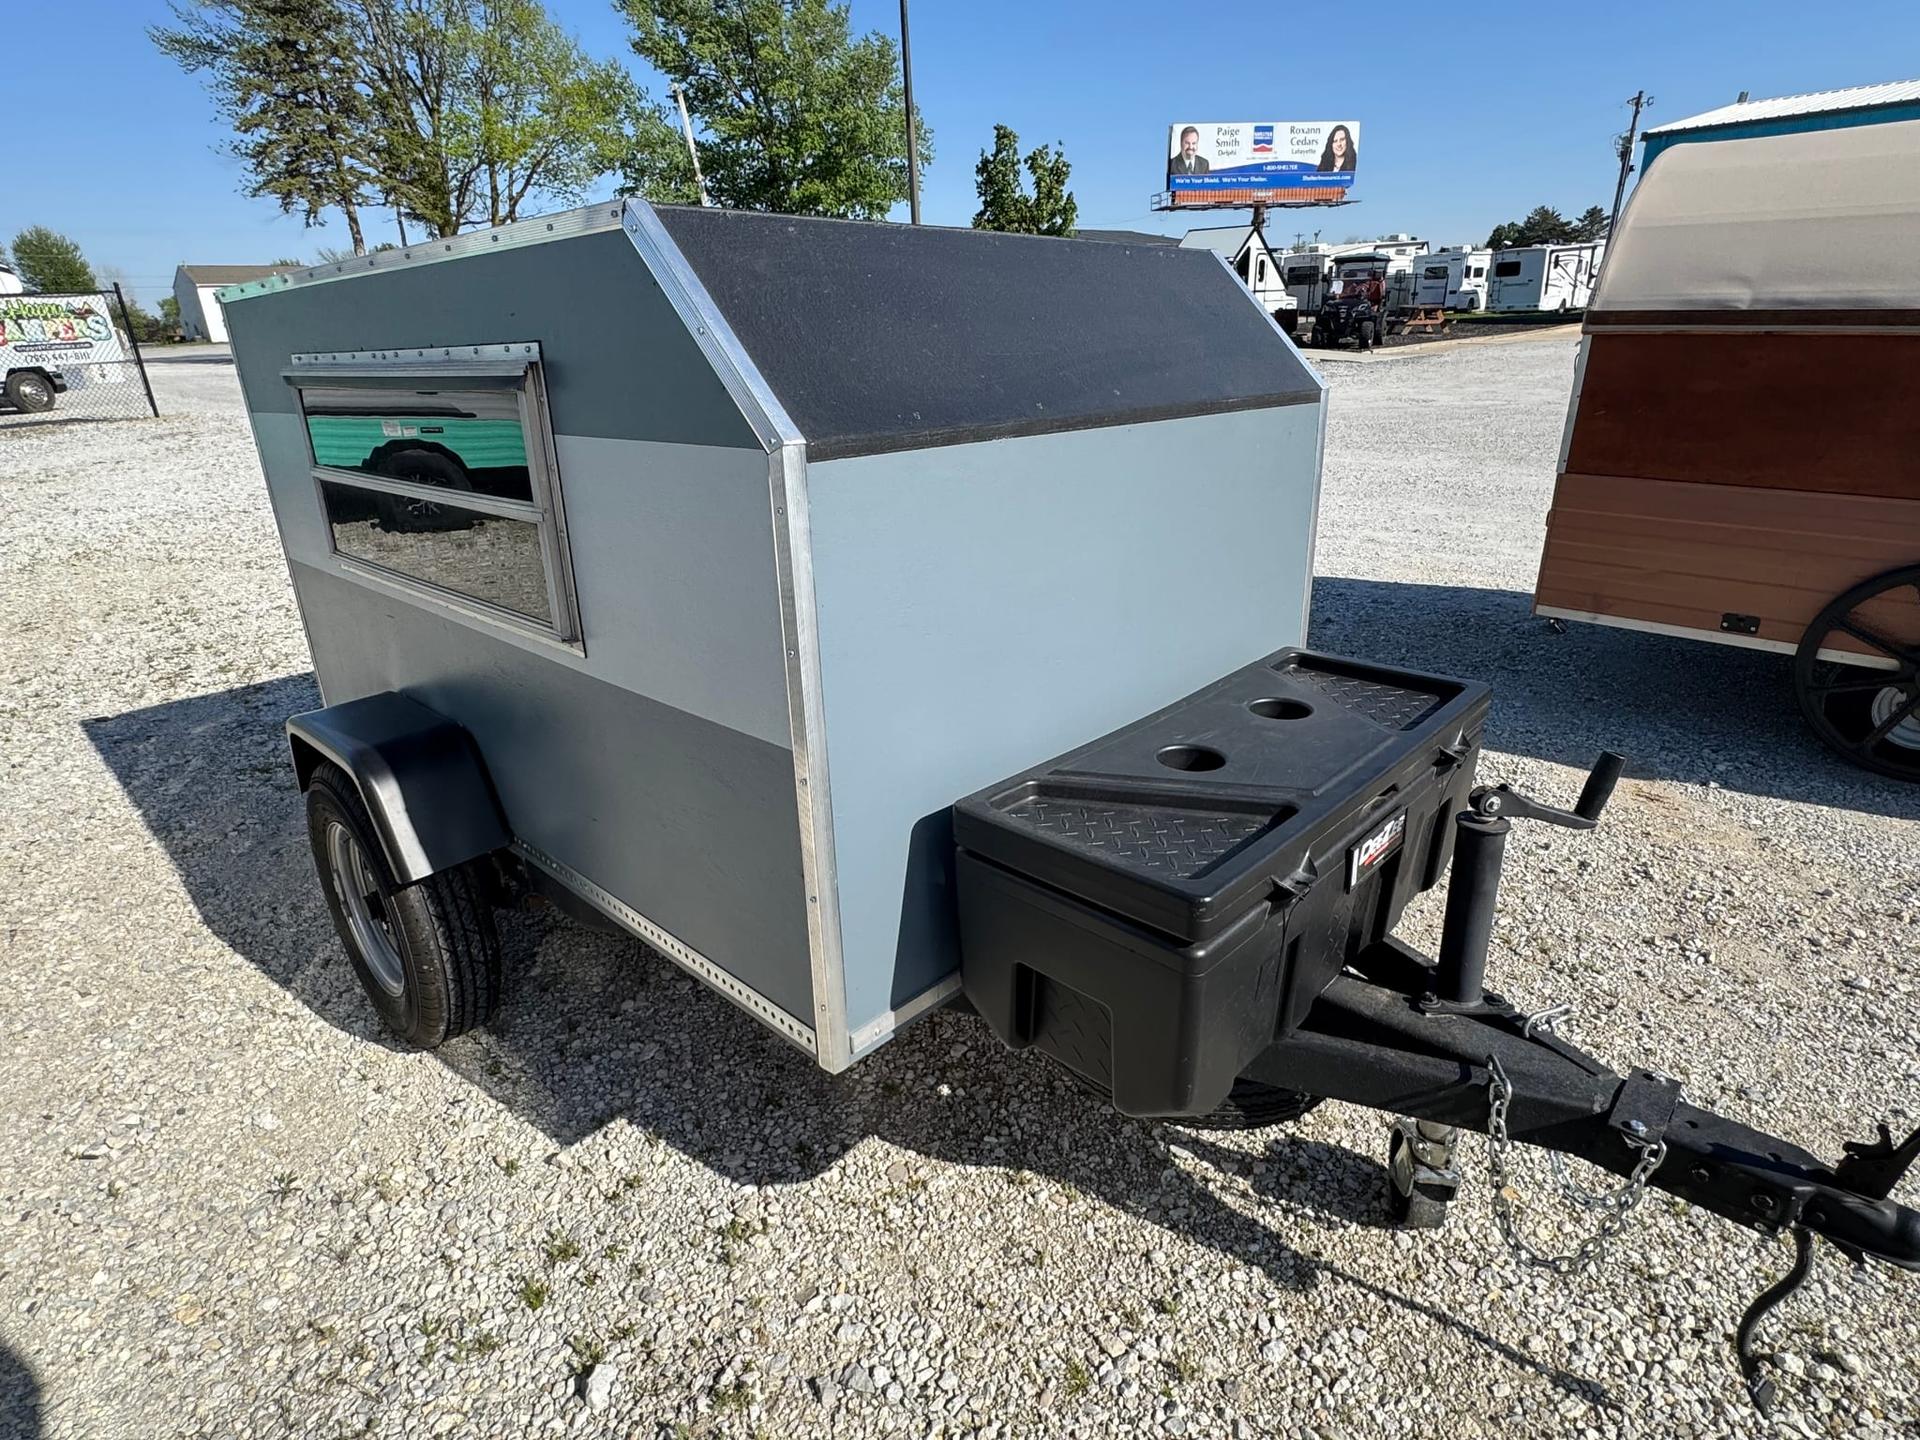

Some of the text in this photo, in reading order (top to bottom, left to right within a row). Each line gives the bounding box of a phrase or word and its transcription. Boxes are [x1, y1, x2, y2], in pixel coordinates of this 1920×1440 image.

[1217, 127, 1240, 137] Paige
[1290, 126, 1321, 135] Roxann
[1216, 137, 1240, 147] Smith
[1290, 136, 1319, 146] Cedars
